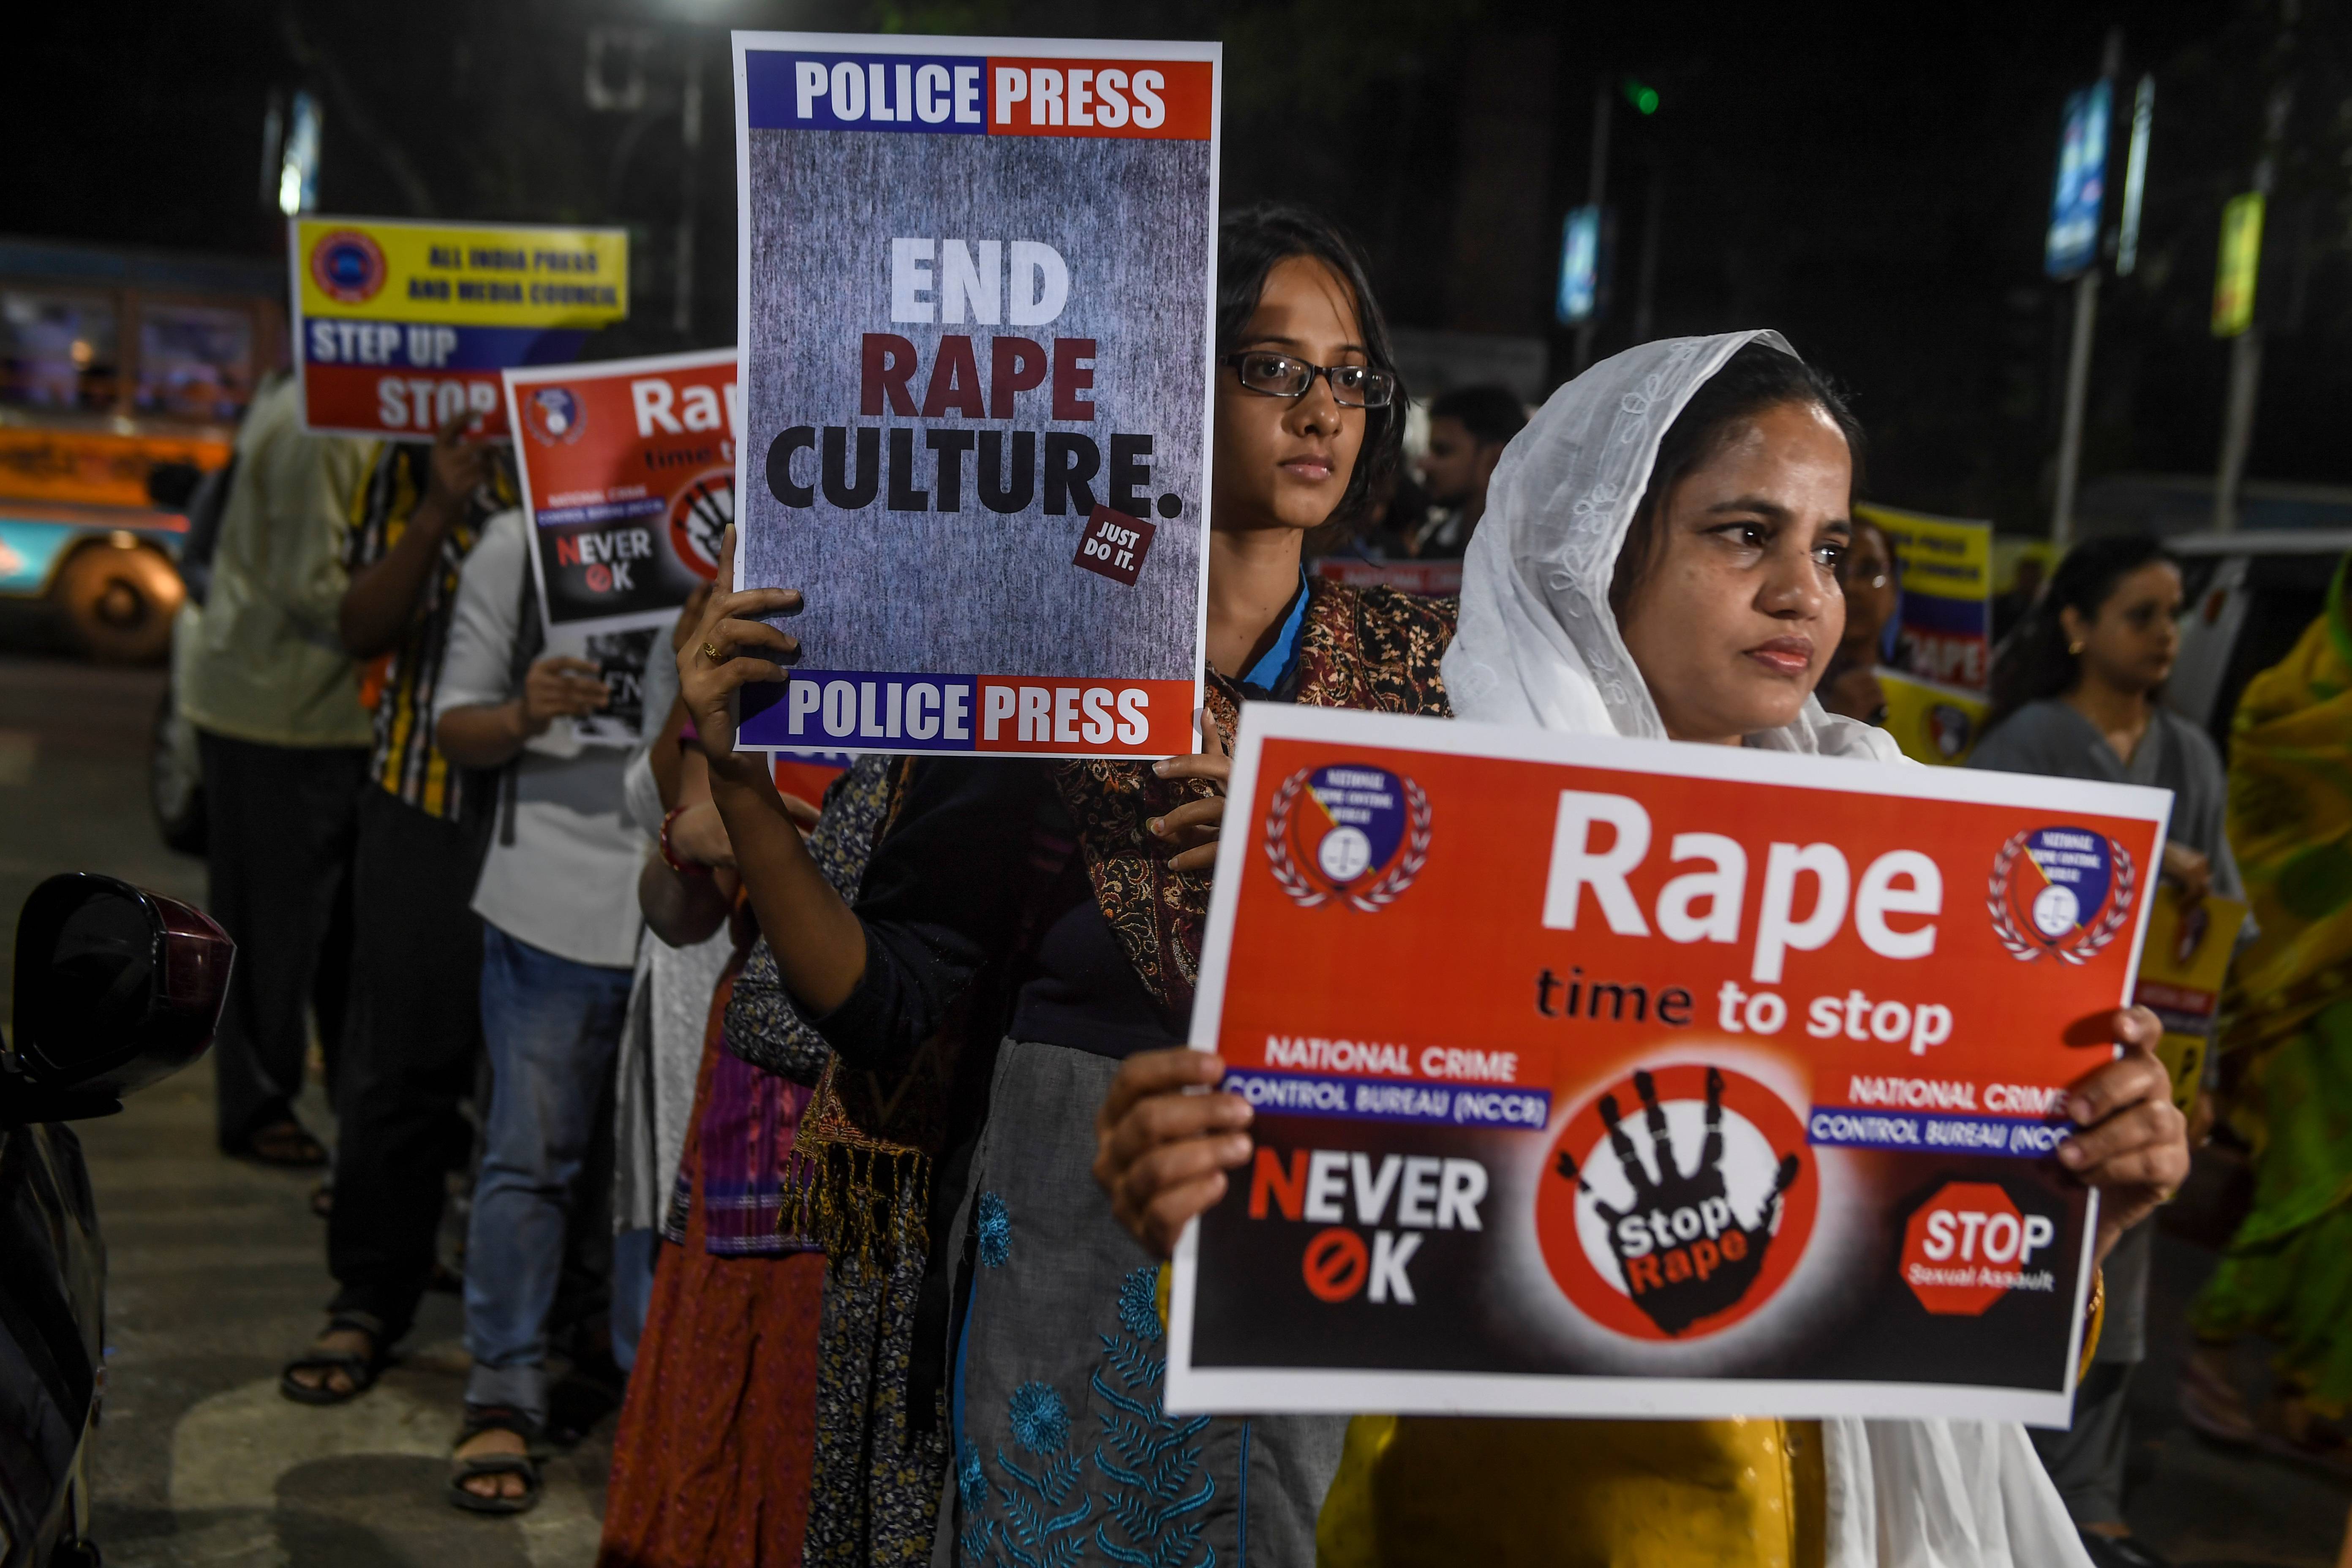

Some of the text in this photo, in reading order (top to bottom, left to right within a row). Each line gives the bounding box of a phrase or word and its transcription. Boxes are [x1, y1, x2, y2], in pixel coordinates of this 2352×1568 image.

[796, 61, 1166, 129] POLICE PRESS
[891, 237, 1068, 326] END
[312, 320, 457, 367] STEP UP
[378, 376, 497, 432] STOP
[860, 332, 1096, 421] RAPE
[766, 425, 1183, 518] CULTURE.
[556, 528, 653, 567] NEVER
[1083, 537, 1134, 571] DO IT.
[1096, 521, 1140, 550] JUST
[788, 680, 1149, 745] POLICE PRESS
[1541, 789, 1944, 984] Rape
[1535, 966, 1953, 1056] time to stop
[1265, 1036, 1518, 1082] NATIONAL CRIME
[1355, 1084, 1449, 1117] BUREAU
[1454, 1092, 1547, 1129] (NCCB)
[1848, 1075, 1977, 1110] NATIONAL
[1811, 1113, 1921, 1144] CONTROL
[1925, 1119, 2008, 1149] BUREAU
[1248, 1145, 1489, 1232] NEVER
[1617, 1195, 1731, 1259] Stop
[1922, 1209, 2055, 1265] STOP
[1626, 1228, 1749, 1295] Rape
[1908, 1262, 2055, 1292] Sexual Assault
